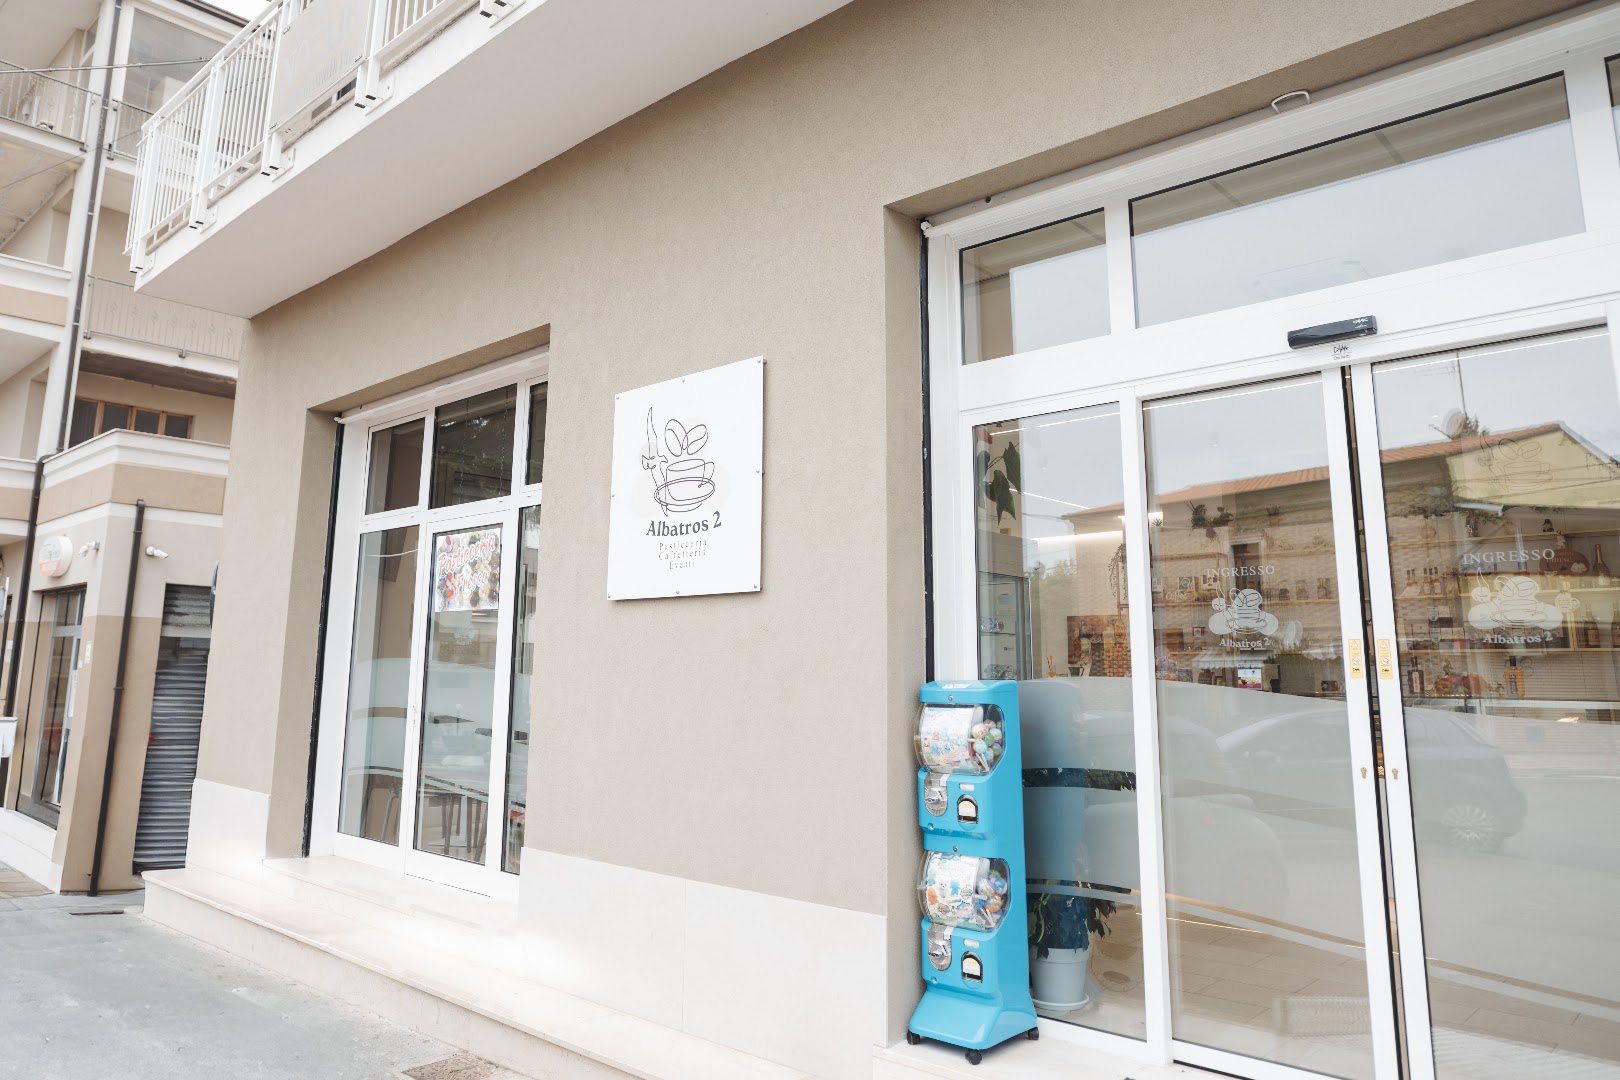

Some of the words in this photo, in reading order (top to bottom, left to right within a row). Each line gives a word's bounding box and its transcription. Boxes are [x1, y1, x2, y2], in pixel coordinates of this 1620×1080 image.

[646, 519, 709, 537] Albatros
[713, 510, 721, 528] 2
[660, 537, 707, 550] Pasticceria
[438, 535, 494, 575] Pasticceria
[659, 548, 706, 560] Caffetteria
[1463, 549, 1555, 565] INGRESSO
[670, 560, 695, 569] Eventi
[1207, 565, 1275, 578] INGRESSO
[1219, 638, 1261, 648] Albatros
[1483, 634, 1541, 645] Albatros
[1544, 632, 1554, 641] 2
